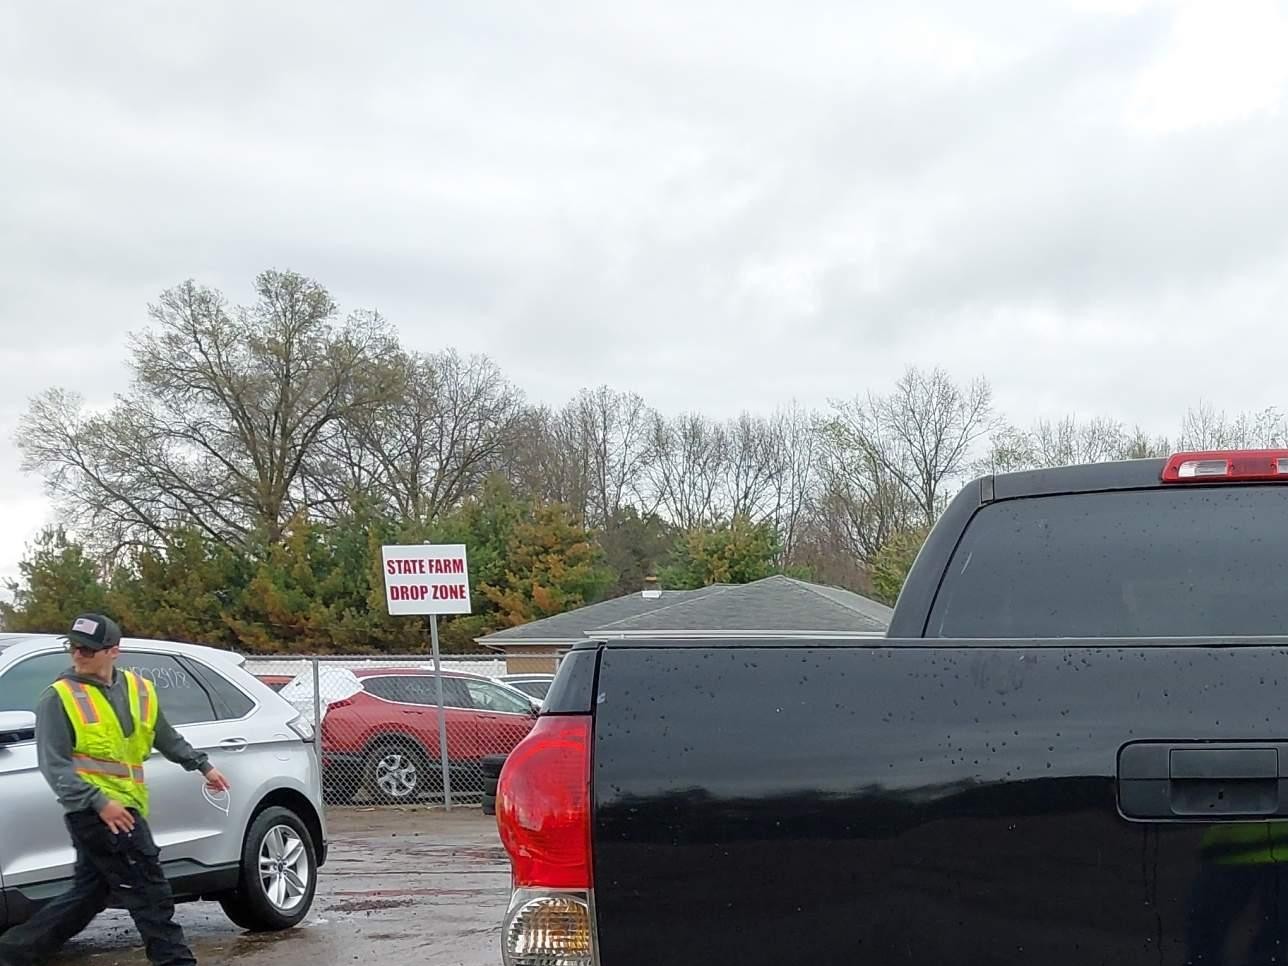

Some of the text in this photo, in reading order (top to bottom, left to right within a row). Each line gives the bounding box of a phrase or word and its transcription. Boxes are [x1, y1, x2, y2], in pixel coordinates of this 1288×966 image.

[387, 558, 465, 575] STATE FARM
[390, 584, 467, 601] DROP ZONE
